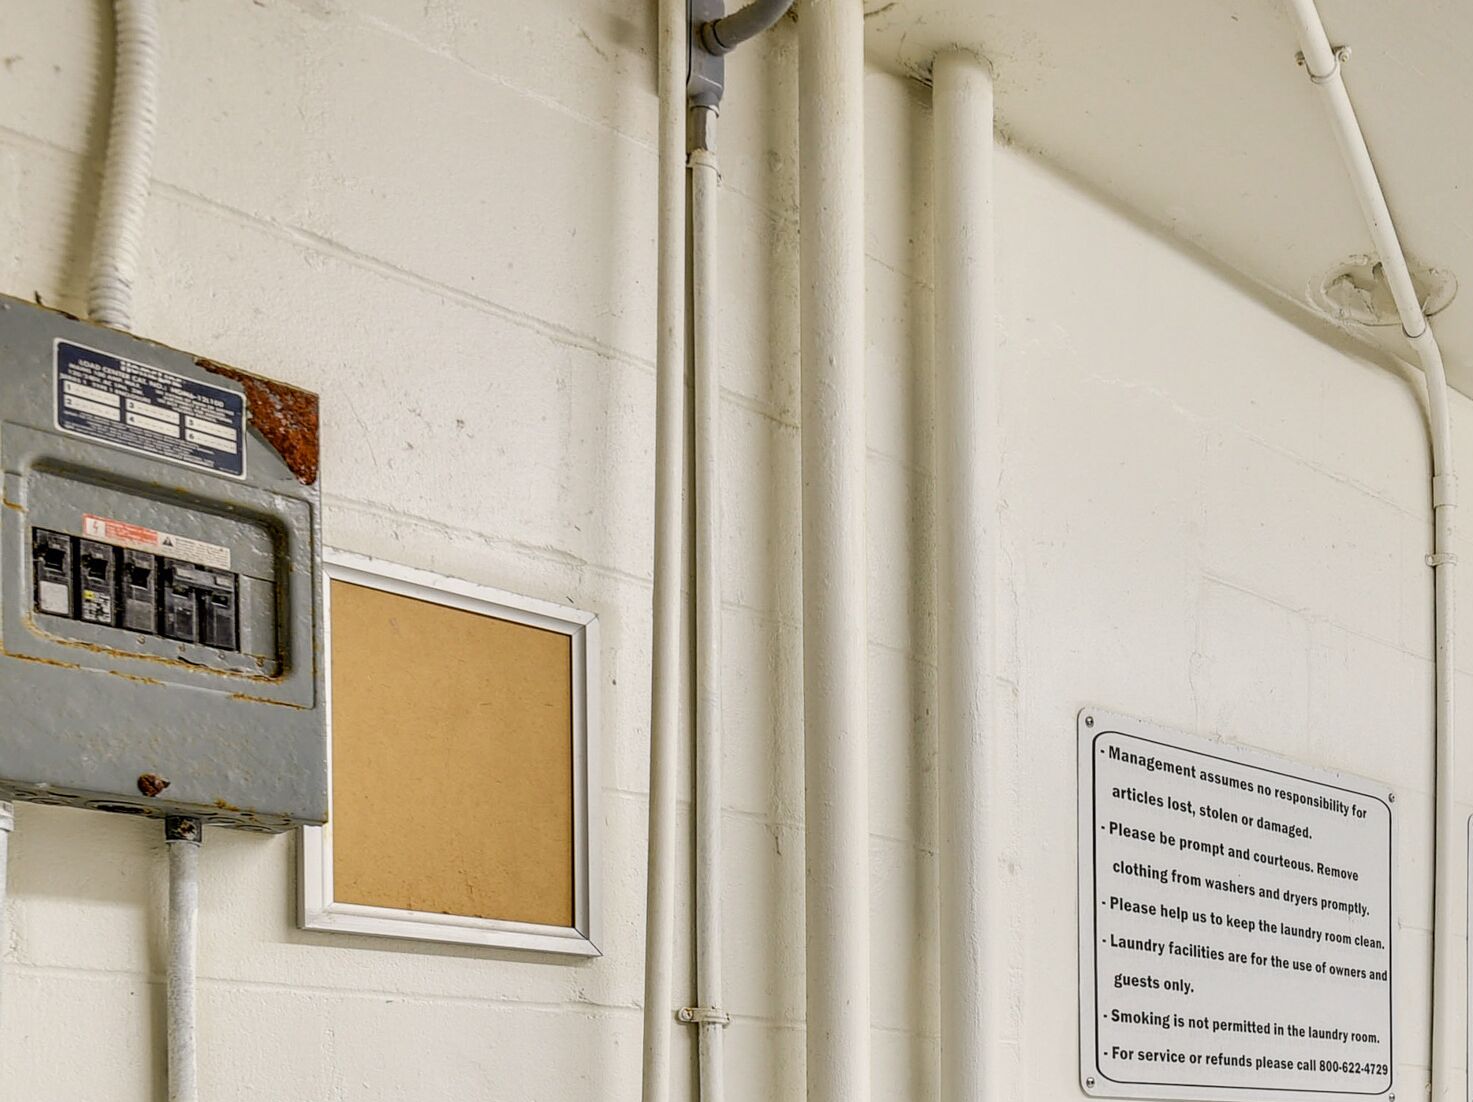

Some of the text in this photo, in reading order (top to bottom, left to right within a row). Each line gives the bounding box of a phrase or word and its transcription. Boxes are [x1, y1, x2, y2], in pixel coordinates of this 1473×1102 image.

[1108, 745, 1367, 819] Management assumes no responsibility for
[1112, 787, 1312, 840] articles lost, stolen or damaged.
[1109, 821, 1359, 882] Please be prompt and courteous. Remove
[1112, 860, 1370, 918] clothing from washers and dryers promptly.
[1110, 896, 1385, 950] Please help us to keep the laundry room clean.
[1110, 933, 1388, 982] Laundry facilities are for the use of owners and
[1114, 973, 1194, 995] guests only.
[1111, 1008, 1380, 1044] Smoking is not permitted in the laundry room.
[1112, 1046, 1388, 1076] For service or refunds please call 800-622-4729
